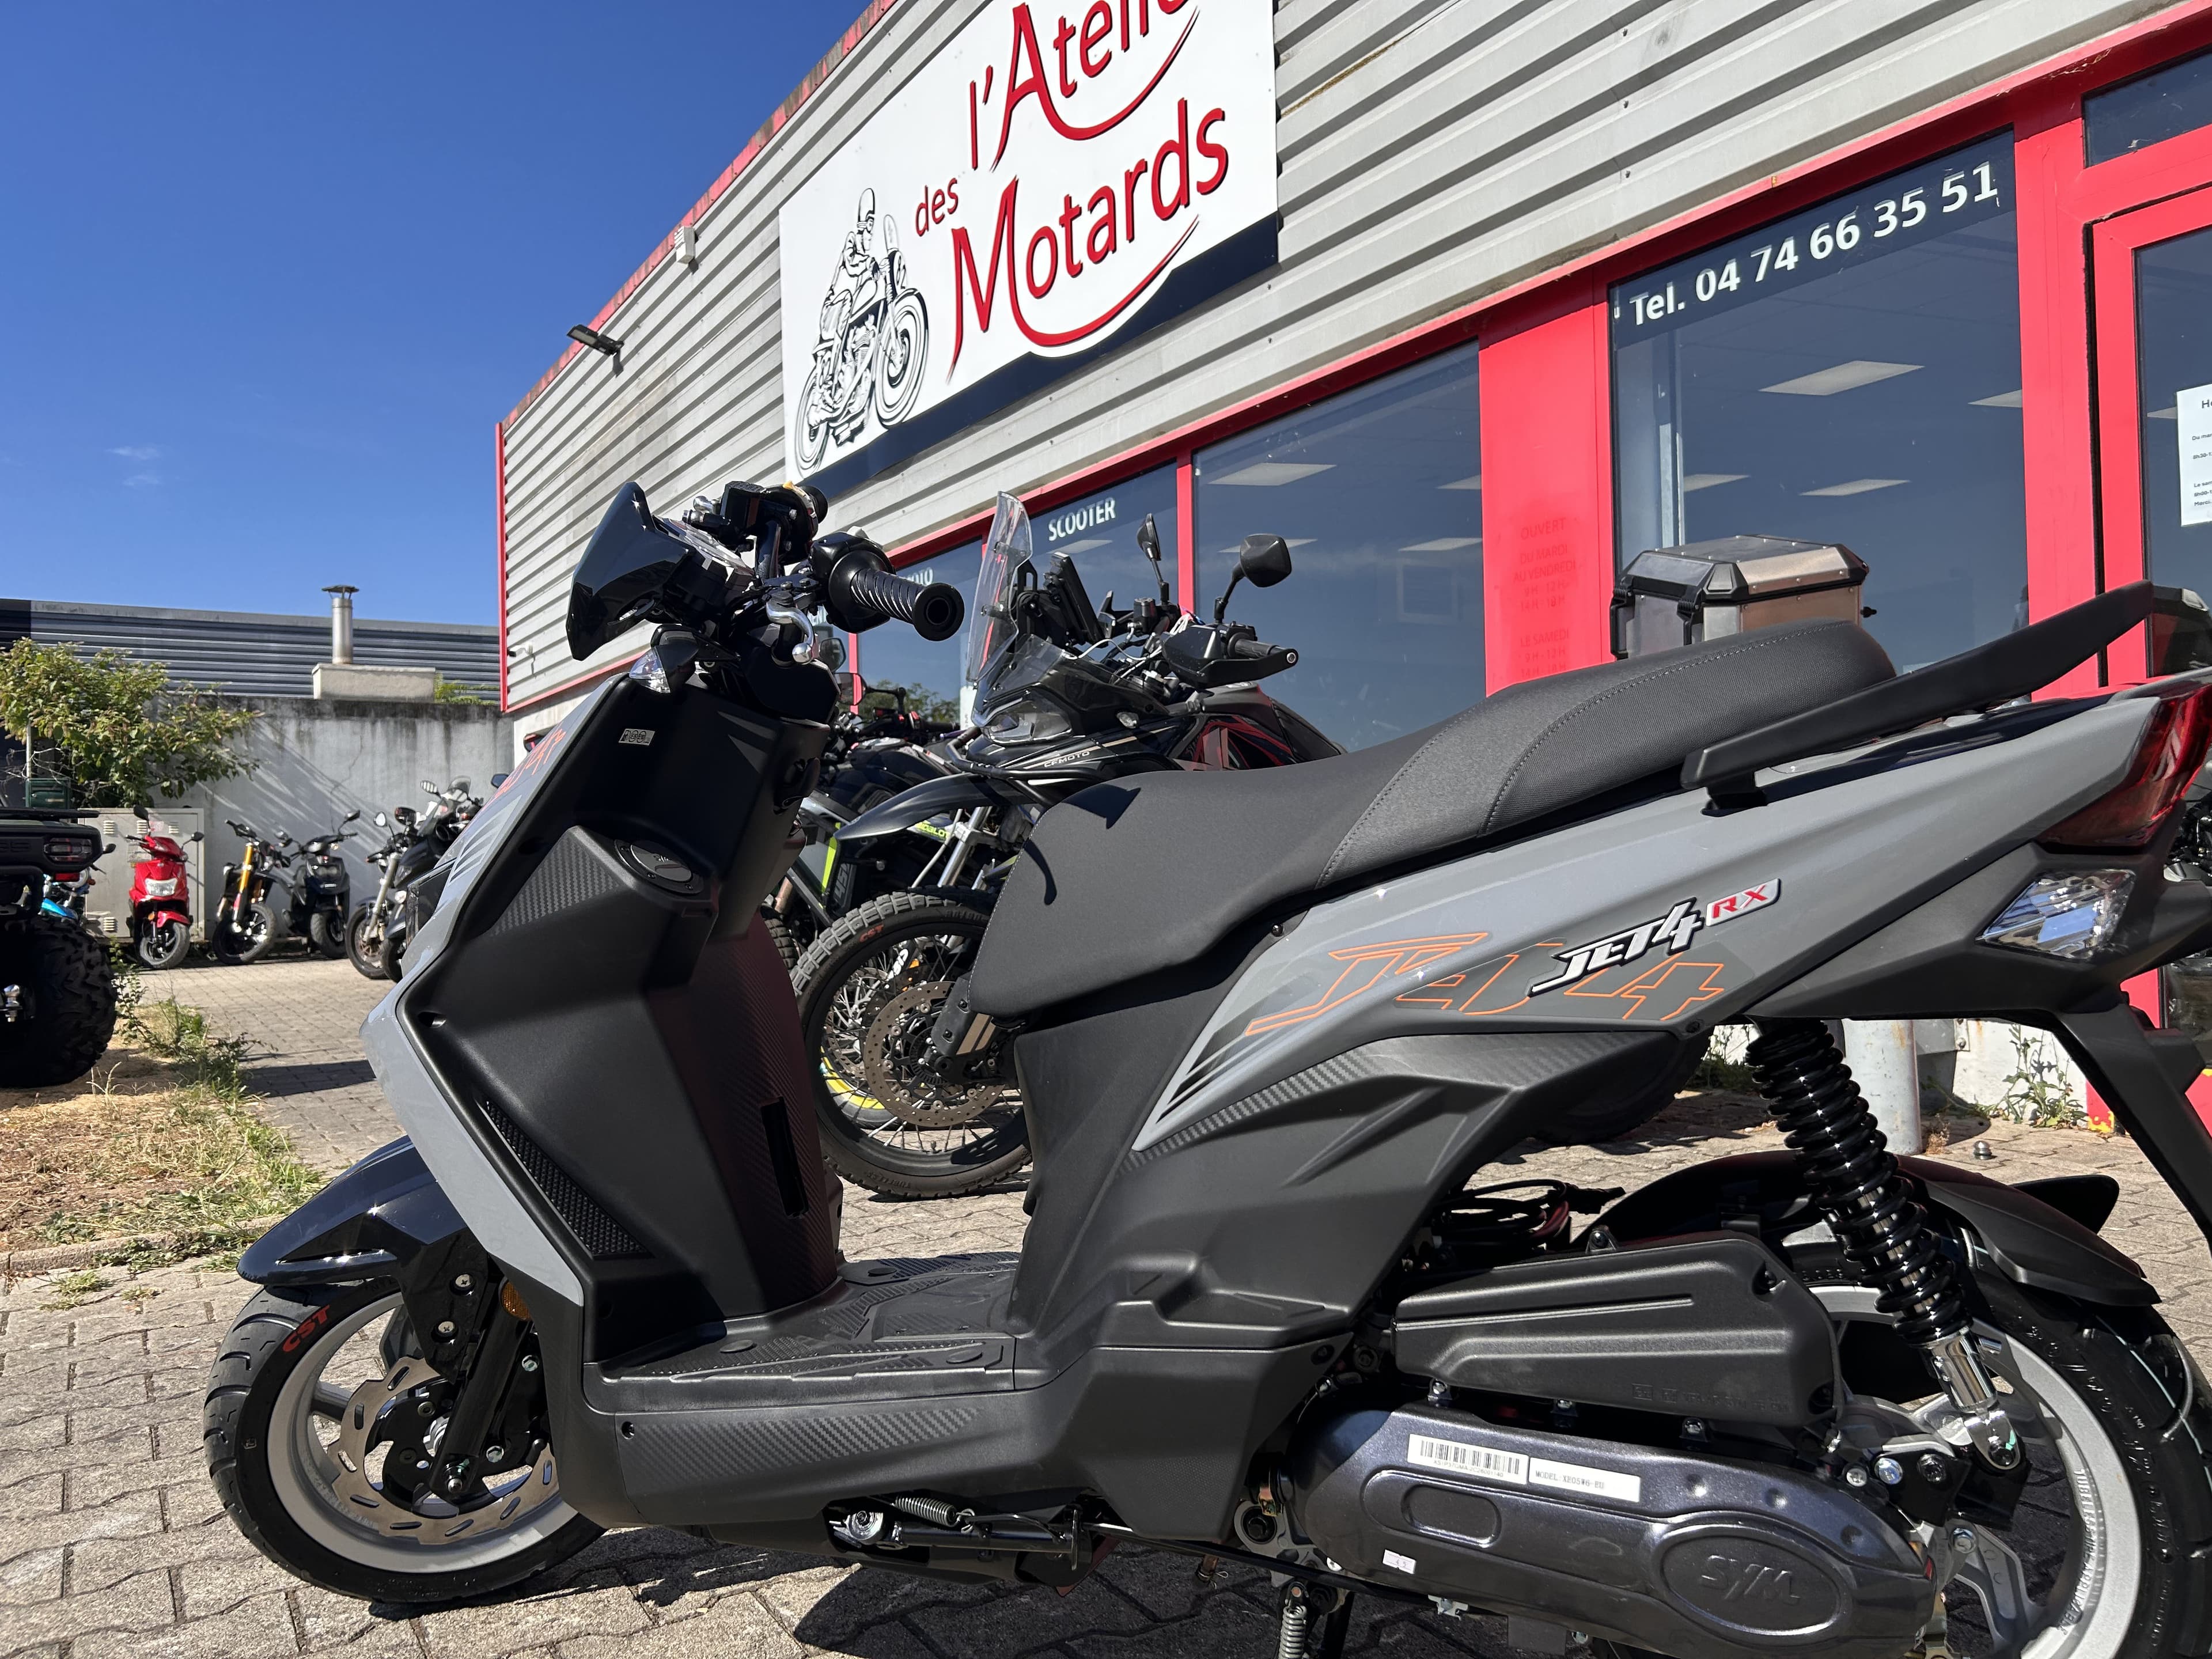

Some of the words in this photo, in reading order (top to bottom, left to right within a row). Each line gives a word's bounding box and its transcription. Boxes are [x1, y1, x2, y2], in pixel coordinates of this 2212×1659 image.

[915, 177, 959, 236] des
[946, 98, 1229, 385] Motards
[1630, 282, 1685, 325] Tel.
[1695, 259, 1741, 302] 04
[1750, 236, 1800, 282] 74
[1810, 213, 1861, 260] 66
[1873, 187, 1926, 237] 35
[1942, 161, 1998, 213] 51
[1048, 497, 1116, 541] SCOOTER
[1520, 516, 1566, 540] OUVERT
[1513, 571, 1527, 584] AU
[1528, 559, 1576, 580] VENDREDI
[1520, 550, 1534, 565] DU
[1536, 543, 1567, 561] MARDI
[1520, 634, 1531, 647] LE
[1533, 628, 1569, 645] SAMEDI
[1044, 751, 1090, 767] CFMOTO
[1529, 899, 1704, 996] JET4
[1713, 884, 1768, 919] RX
[282, 1304, 331, 1353] CST
